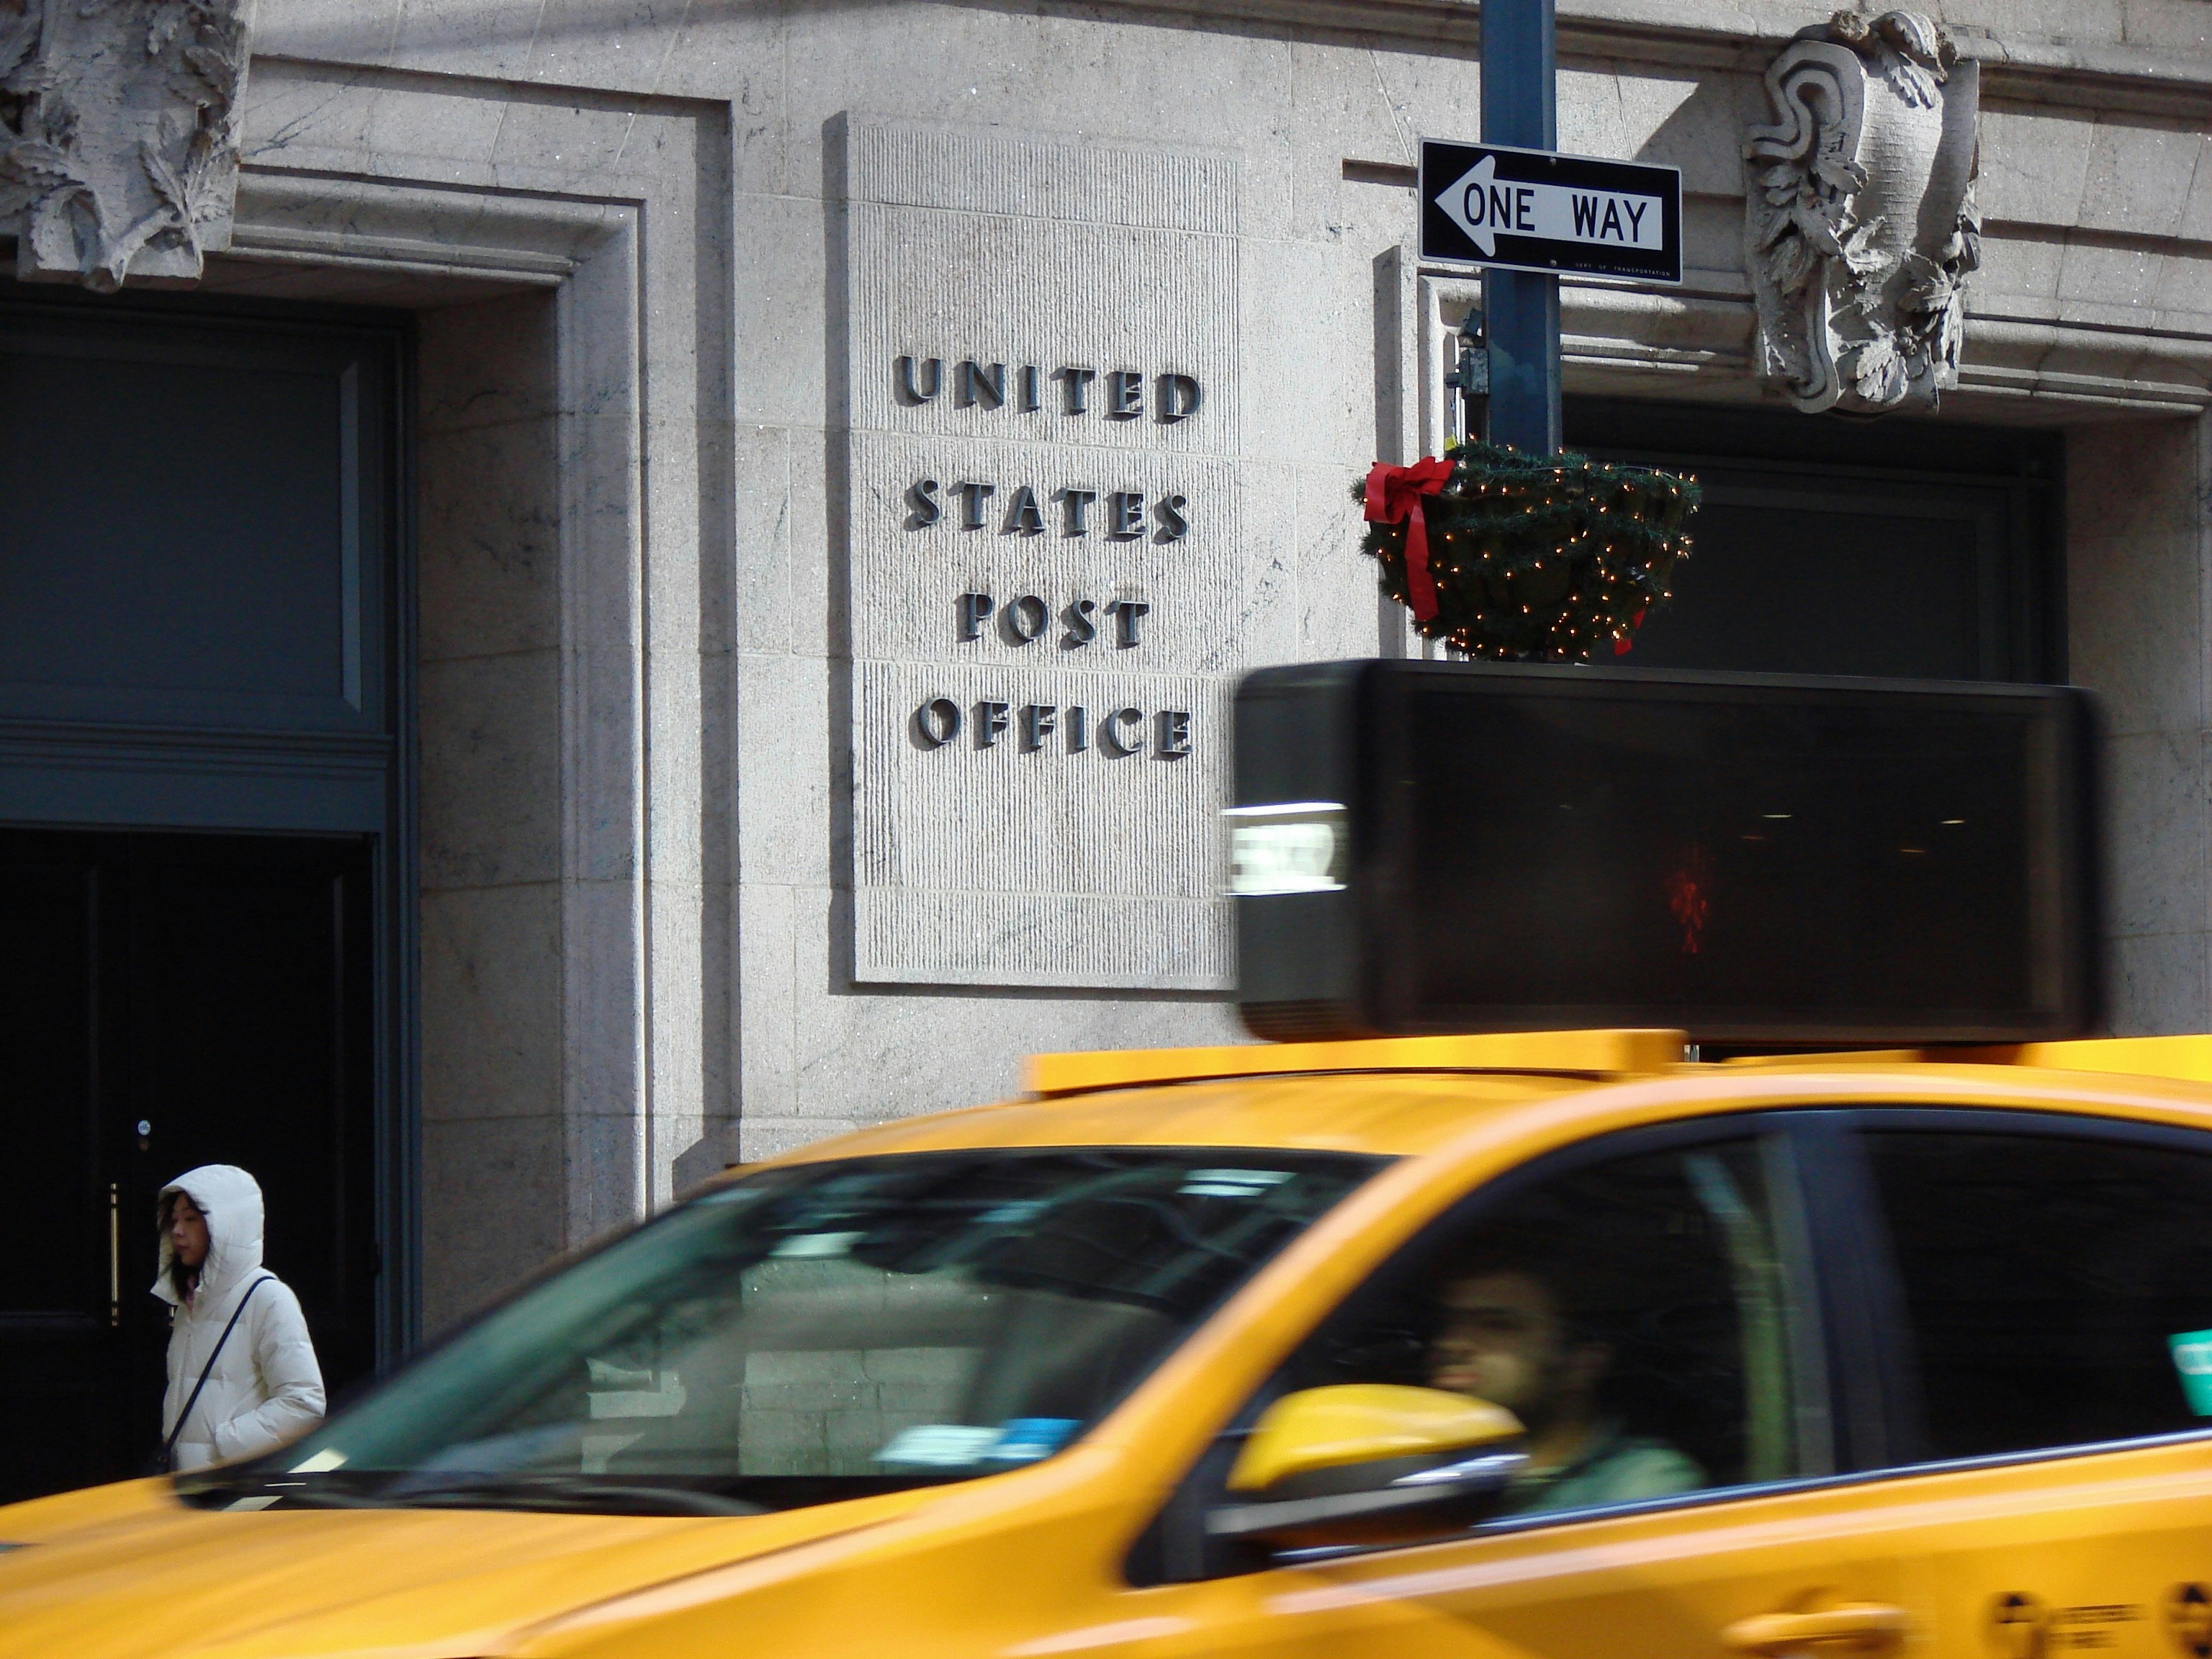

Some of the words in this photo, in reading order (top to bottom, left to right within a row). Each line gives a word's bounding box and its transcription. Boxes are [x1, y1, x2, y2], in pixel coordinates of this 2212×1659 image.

[1463, 182, 1535, 231] ONE
[1572, 194, 1647, 243] WAY
[1614, 266, 1670, 276] TRANSPORTATION
[894, 355, 1201, 423] UNITED
[904, 478, 1187, 544] STATES
[955, 593, 1149, 649] POST
[909, 698, 1192, 761] OFFICE
